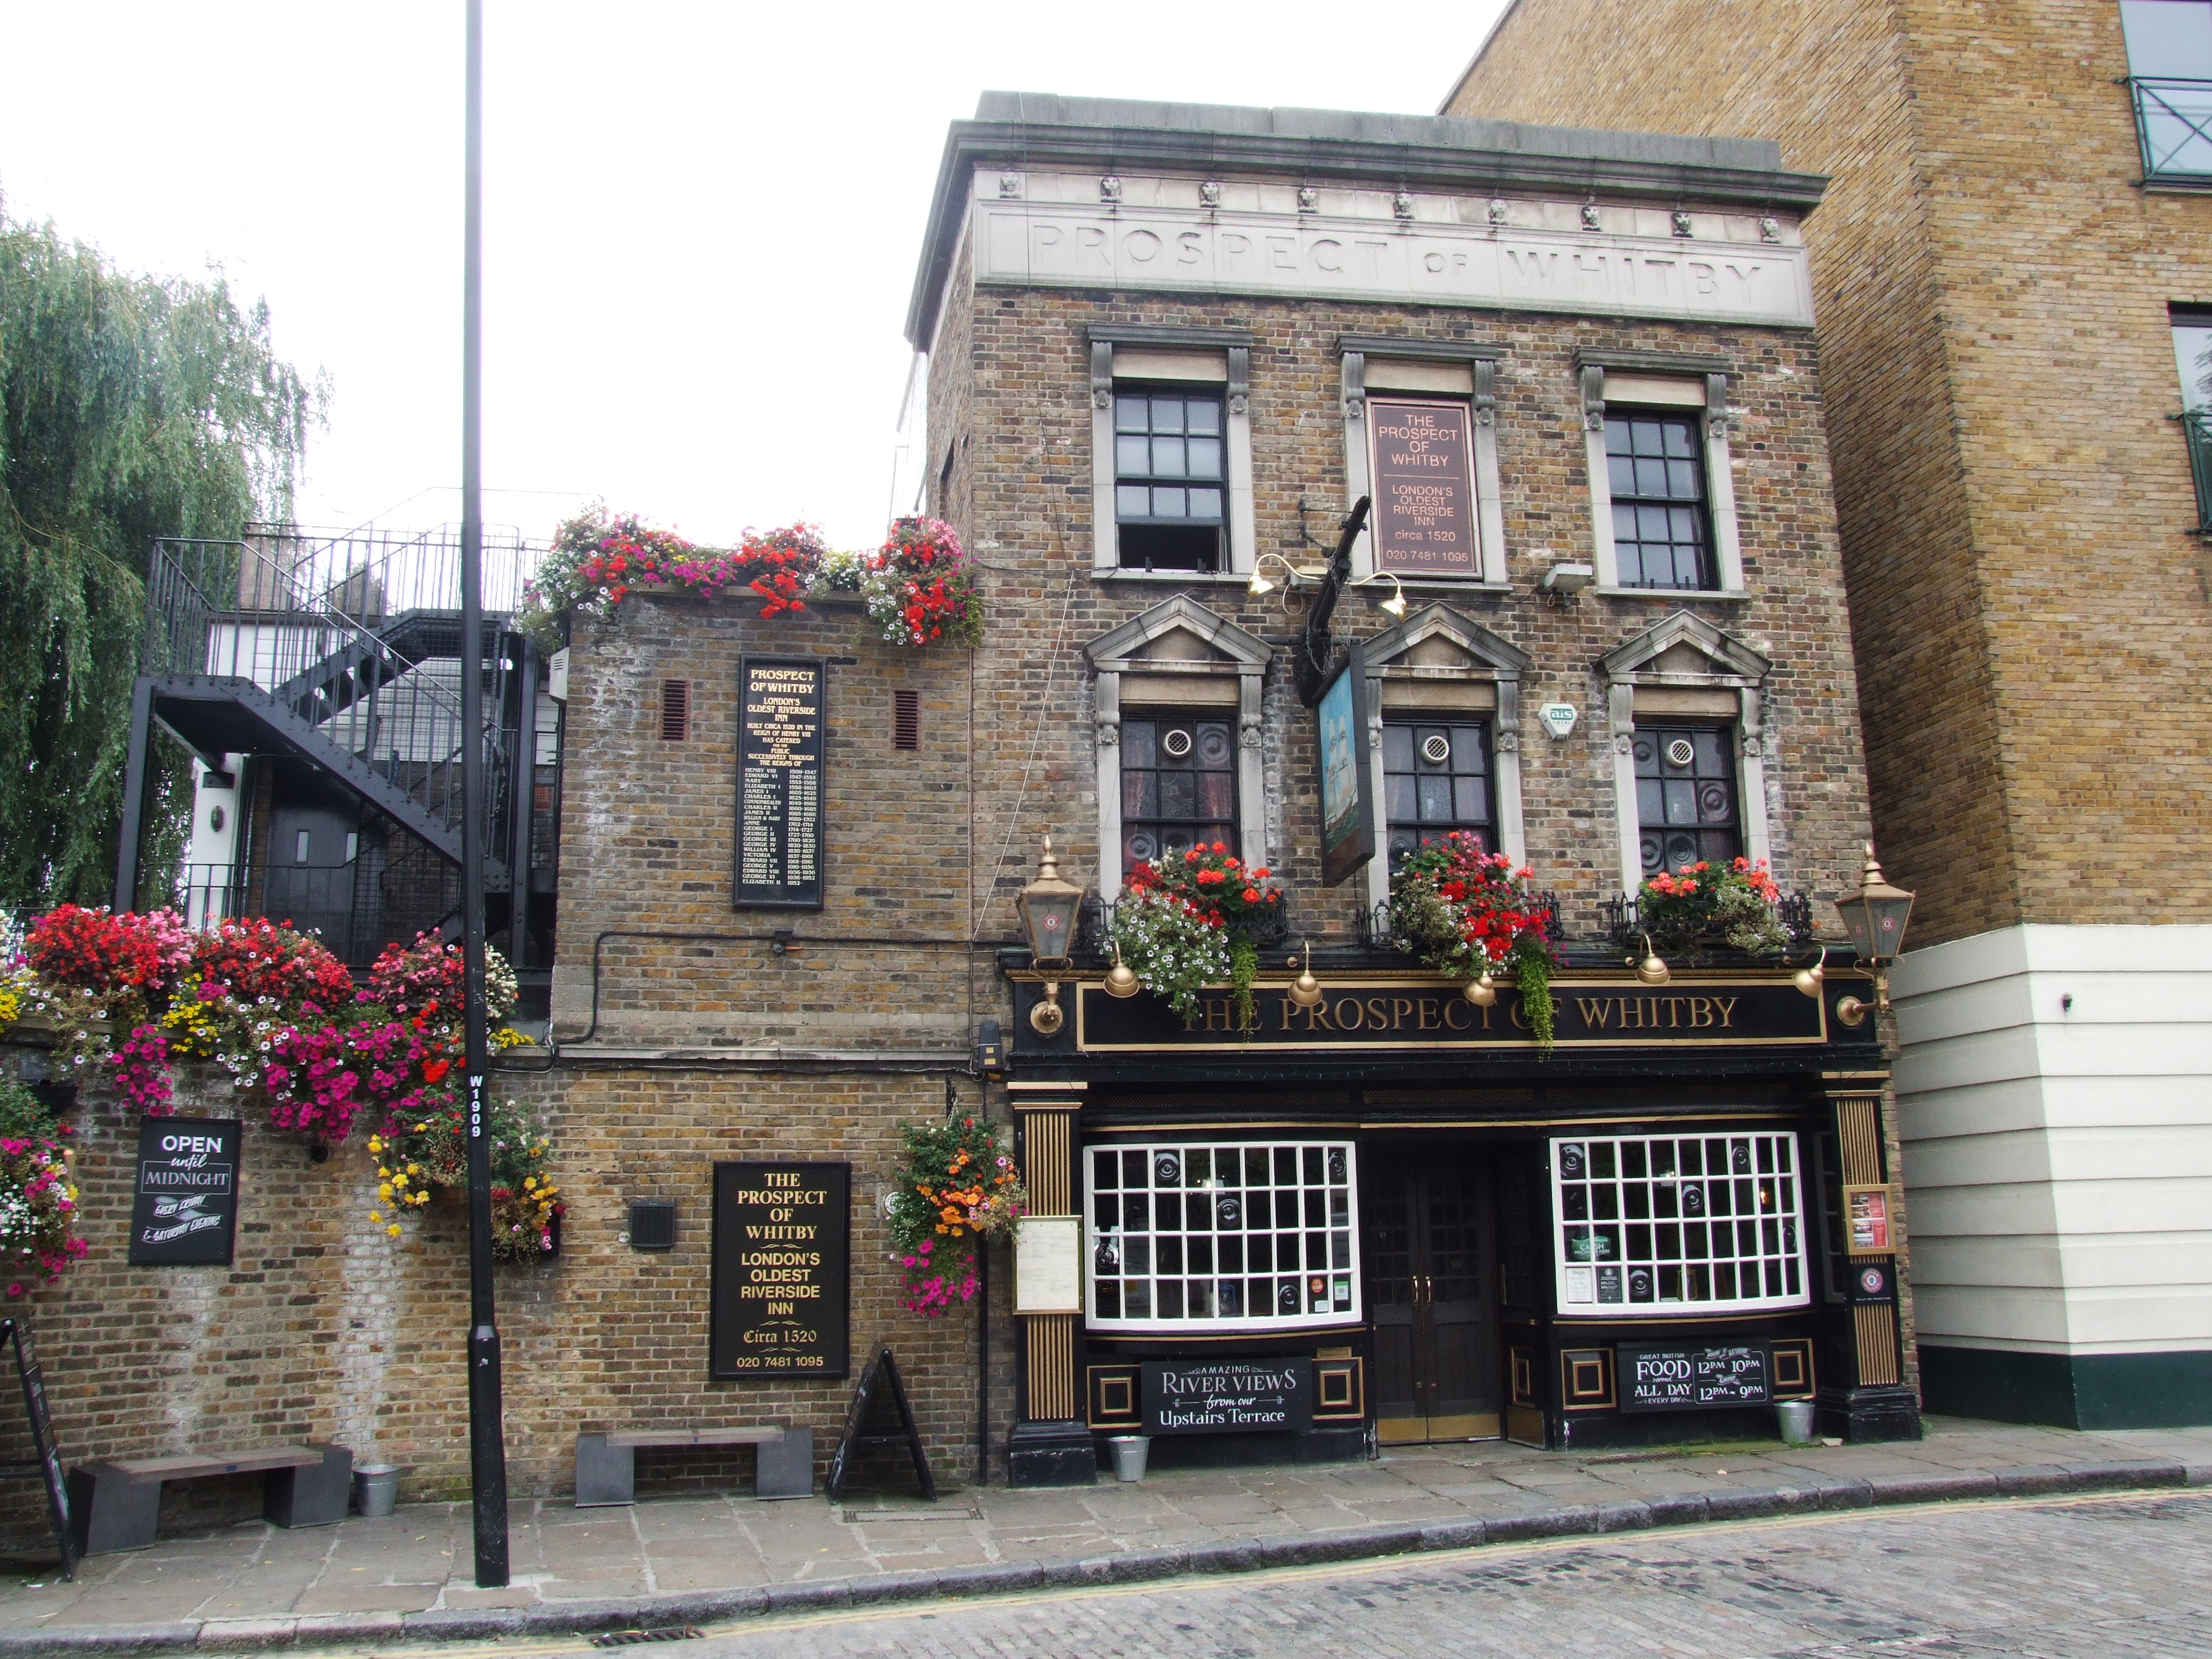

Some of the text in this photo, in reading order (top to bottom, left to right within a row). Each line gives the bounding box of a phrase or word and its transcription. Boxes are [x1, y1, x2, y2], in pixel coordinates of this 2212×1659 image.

[1033, 224, 1762, 304] PROSPECT OF WHITBY
[1405, 415, 1435, 427] THE
[1379, 426, 1457, 441] PROSPECT
[1409, 441, 1429, 453] OF
[1391, 453, 1448, 467] WHITBY
[1393, 485, 1452, 497] LONDON'S
[1400, 495, 1445, 506] OLDEST
[1394, 506, 1454, 516] RIVERSIDE
[1414, 516, 1435, 526] INN
[1395, 530, 1455, 542] circa 1520
[1386, 550, 1468, 562] 020 7481 1095
[751, 669, 815, 681] PROSPECT
[750, 682, 815, 693] OF WHITBY
[764, 697, 800, 706] LONDON'S
[748, 705, 816, 715] OLDEST RIVERSIDE
[1574, 996, 1740, 1029] WHITBY
[470, 1075, 483, 1137] W1909
[162, 1135, 223, 1153] OPEN
[171, 1154, 207, 1171] until
[145, 1172, 228, 1185] MIDNIGHT
[764, 1173, 800, 1187] THE
[737, 1191, 827, 1205] PROSPECT
[155, 1195, 206, 1215] EVERY FRIDAY
[770, 1209, 793, 1222] OF
[152, 1222, 191, 1241] SATURDAY
[190, 1215, 221, 1232] EVENING
[746, 1226, 817, 1239] WHITBY
[741, 1253, 820, 1266] LONDON'S
[751, 1269, 811, 1282] OLDEST
[741, 1285, 820, 1298] RIVERSIDE
[767, 1302, 793, 1315] INN
[743, 1329, 817, 1344] Circa 1520
[737, 1356, 823, 1368] 020 7481 1095
[1698, 1360, 1760, 1374] 12PM 10PM
[1200, 1365, 1250, 1374] AMAZING
[1636, 1360, 1691, 1380] FOOD
[1162, 1369, 1296, 1394] RIVER VIEWS
[1634, 1383, 1693, 1396] ALL DAY
[1700, 1386, 1763, 1400] 12PM 9PM
[1206, 1394, 1256, 1409] from our
[1160, 1409, 1285, 1428] Upstairs Terrace
